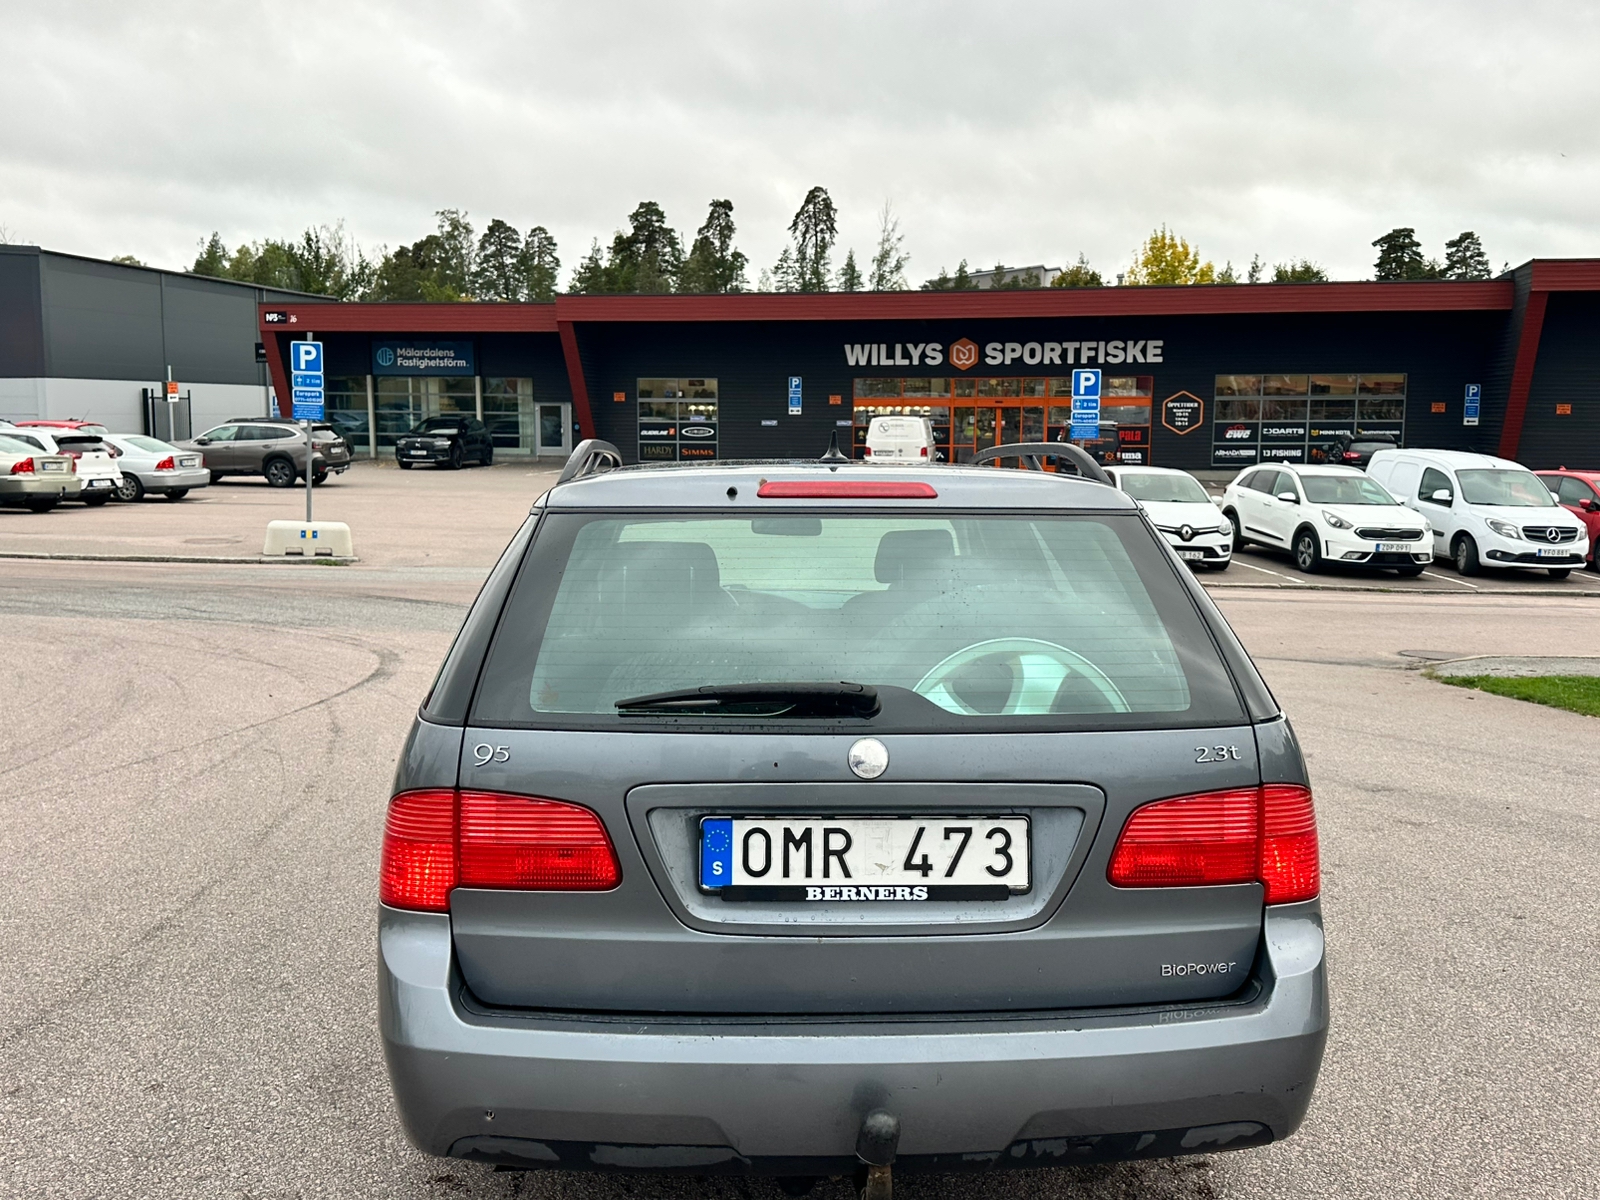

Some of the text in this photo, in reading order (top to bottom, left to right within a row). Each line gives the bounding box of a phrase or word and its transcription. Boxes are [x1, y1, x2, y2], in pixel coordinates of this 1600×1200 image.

[299, 345, 317, 370] P
[397, 347, 455, 357] Mälardalens
[844, 340, 1164, 366] WILLYS SPORTFISKE
[791, 378, 800, 389] P
[1079, 372, 1096, 395] P
[1469, 386, 1478, 397] P
[1119, 430, 1142, 441] PALA
[1225, 429, 1252, 439] CWC
[644, 446, 673, 454] HARDY
[681, 448, 714, 456] SIMMS
[1262, 449, 1271, 457] 13
[1271, 449, 1302, 457] FISHING
[473, 742, 511, 767] 95
[1195, 744, 1242, 763] 2.3t
[741, 826, 1013, 879] OMR 473
[712, 861, 723, 876] S
[805, 885, 929, 901] BERNERS
[1161, 961, 1237, 977] BioPower
